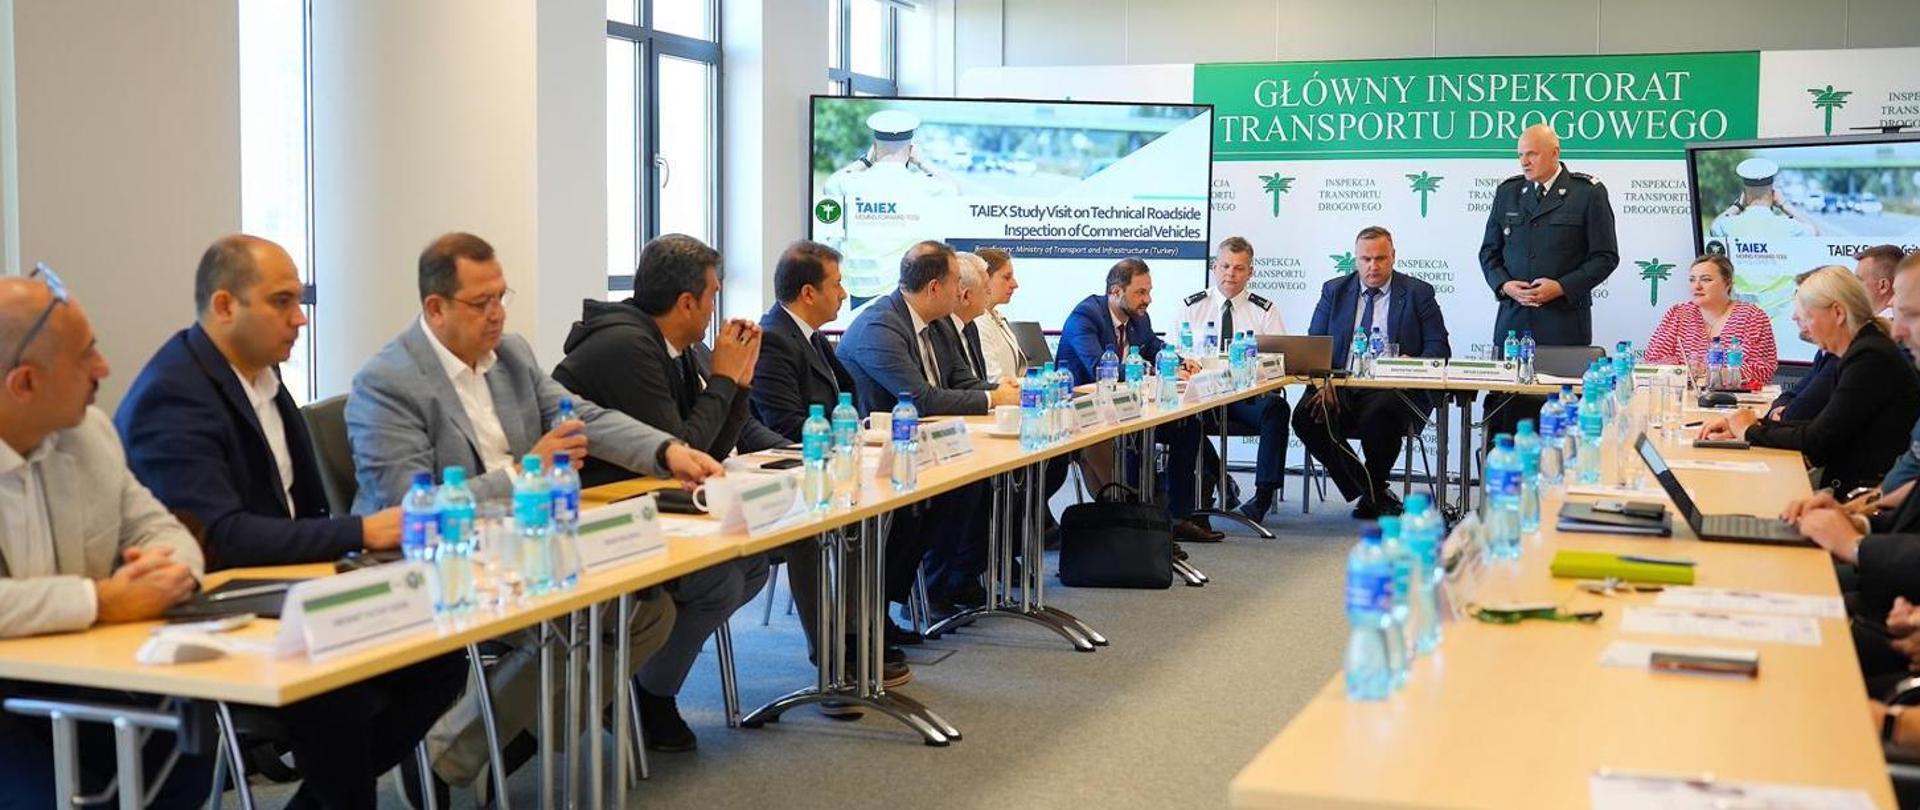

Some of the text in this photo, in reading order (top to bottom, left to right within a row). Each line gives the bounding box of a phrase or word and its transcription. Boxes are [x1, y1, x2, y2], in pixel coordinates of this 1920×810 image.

[1253, 70, 1690, 108] GŁÓWNY INSPEKTORAT
[1218, 110, 1455, 145] TRANSPORTU
[1325, 178, 1376, 188] INSPEKCJA
[1631, 179, 1687, 189] INSPEKCJA
[1318, 191, 1381, 199] TRANSPORTU
[856, 202, 897, 213] TAIEX
[1318, 202, 1382, 211] DROGOWEGO
[969, 204, 1008, 217] TAIEX
[1009, 205, 1045, 221] Study
[1046, 205, 1072, 218] Visit
[1073, 208, 1090, 218] on
[1091, 206, 1145, 219] Technical
[1147, 207, 1201, 220] Roadside
[1004, 224, 1201, 240] Inspection of Commercial Vehicles
[1016, 245, 1043, 254] Ministry
[1044, 246, 1053, 255] of
[1053, 245, 1086, 255] Transport
[1150, 246, 1178, 256] (Turkey)
[1735, 243, 1768, 253] TAIEX
[1827, 244, 1860, 256] TAIEX
[1254, 257, 1301, 266] NSPEKCJA
